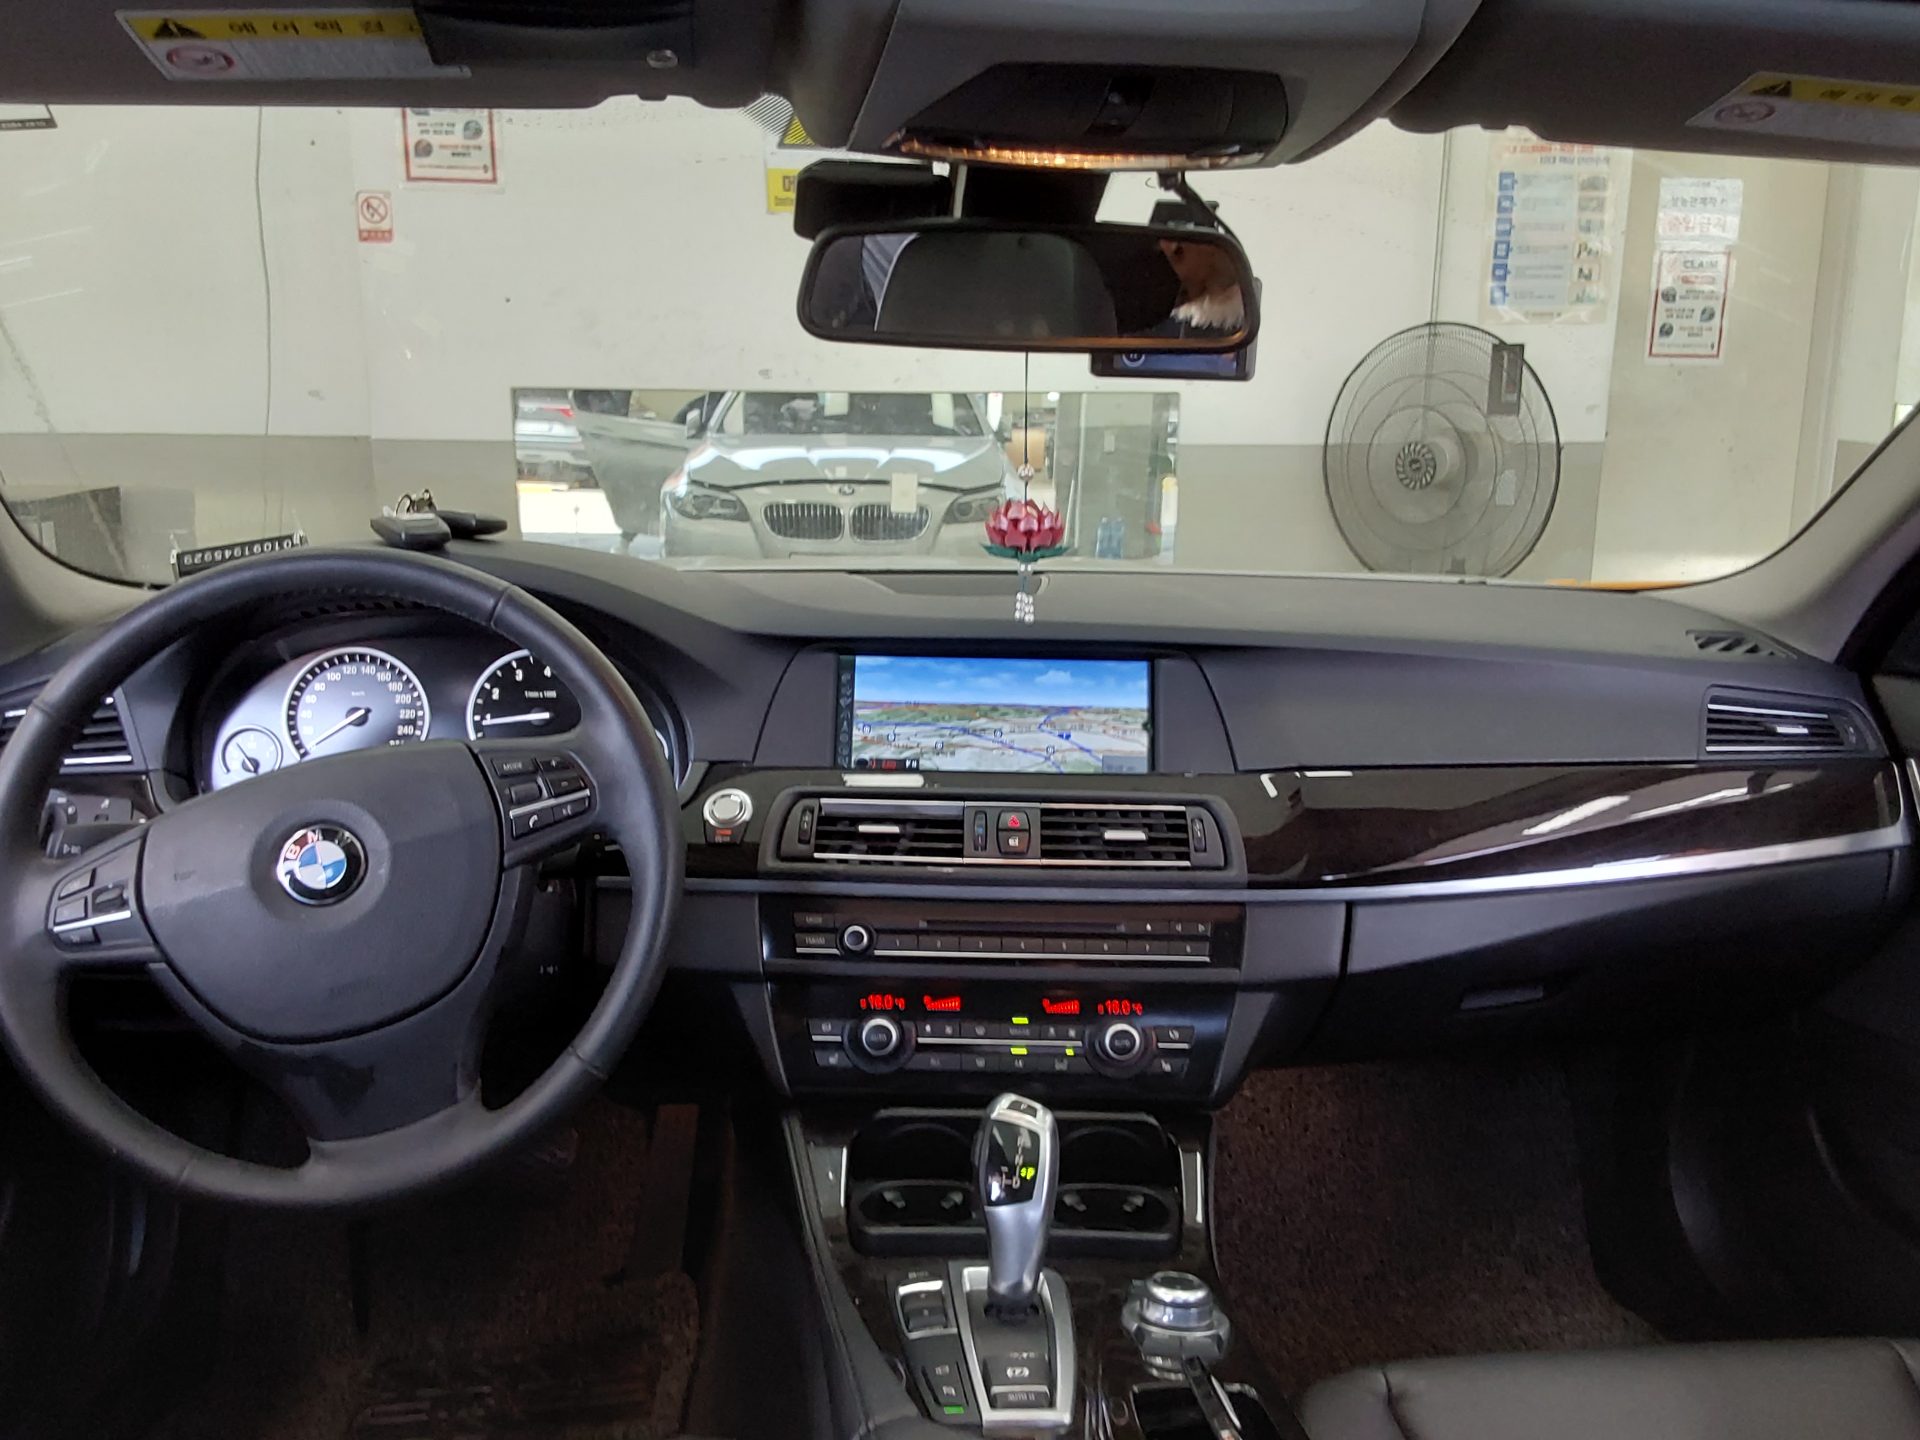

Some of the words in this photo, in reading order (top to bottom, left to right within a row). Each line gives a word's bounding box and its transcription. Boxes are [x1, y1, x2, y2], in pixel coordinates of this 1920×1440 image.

[343, 666, 357, 675] 120
[361, 665, 376, 675] 140
[515, 668, 524, 682] 3
[326, 672, 341, 682] 100
[491, 687, 500, 700] 2
[395, 694, 412, 704] 200
[399, 709, 416, 719] 220
[397, 725, 414, 736] 240
